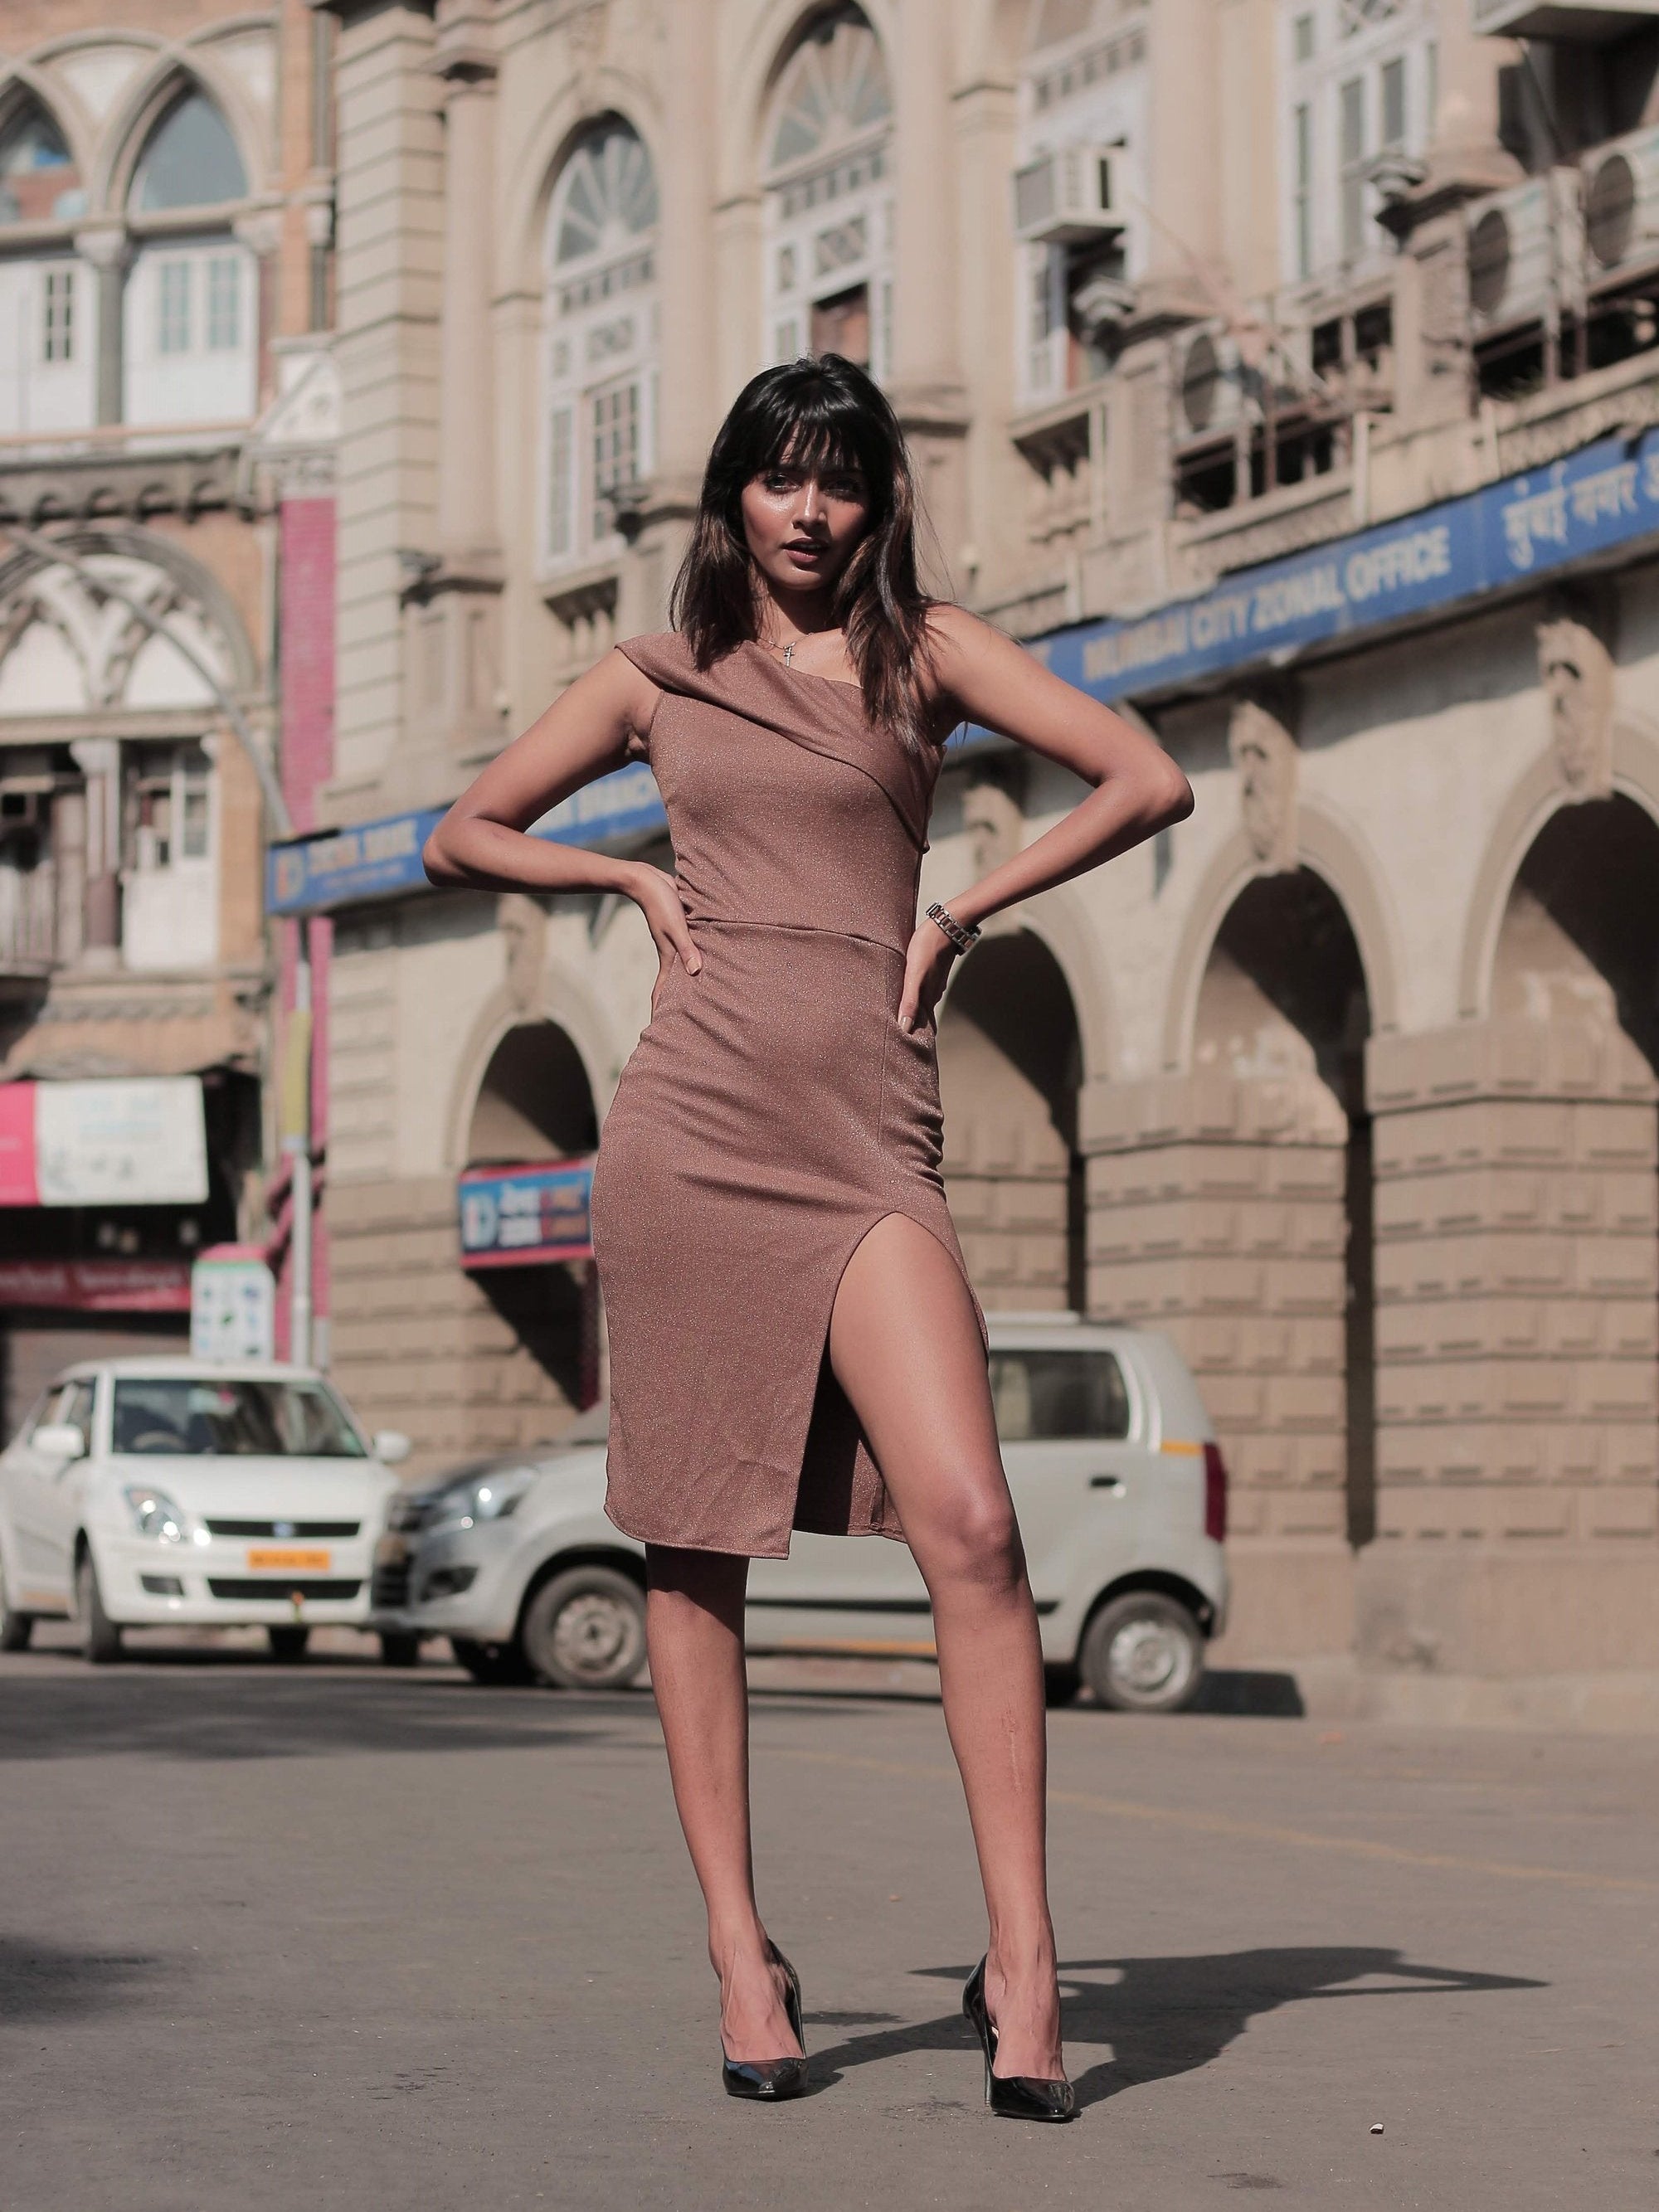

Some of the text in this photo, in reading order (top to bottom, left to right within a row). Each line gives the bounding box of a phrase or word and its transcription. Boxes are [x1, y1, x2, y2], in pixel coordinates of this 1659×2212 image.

[1190, 589, 1251, 651] CITY
[1252, 562, 1344, 633] ZONAL
[1345, 524, 1451, 601] OFFICE
